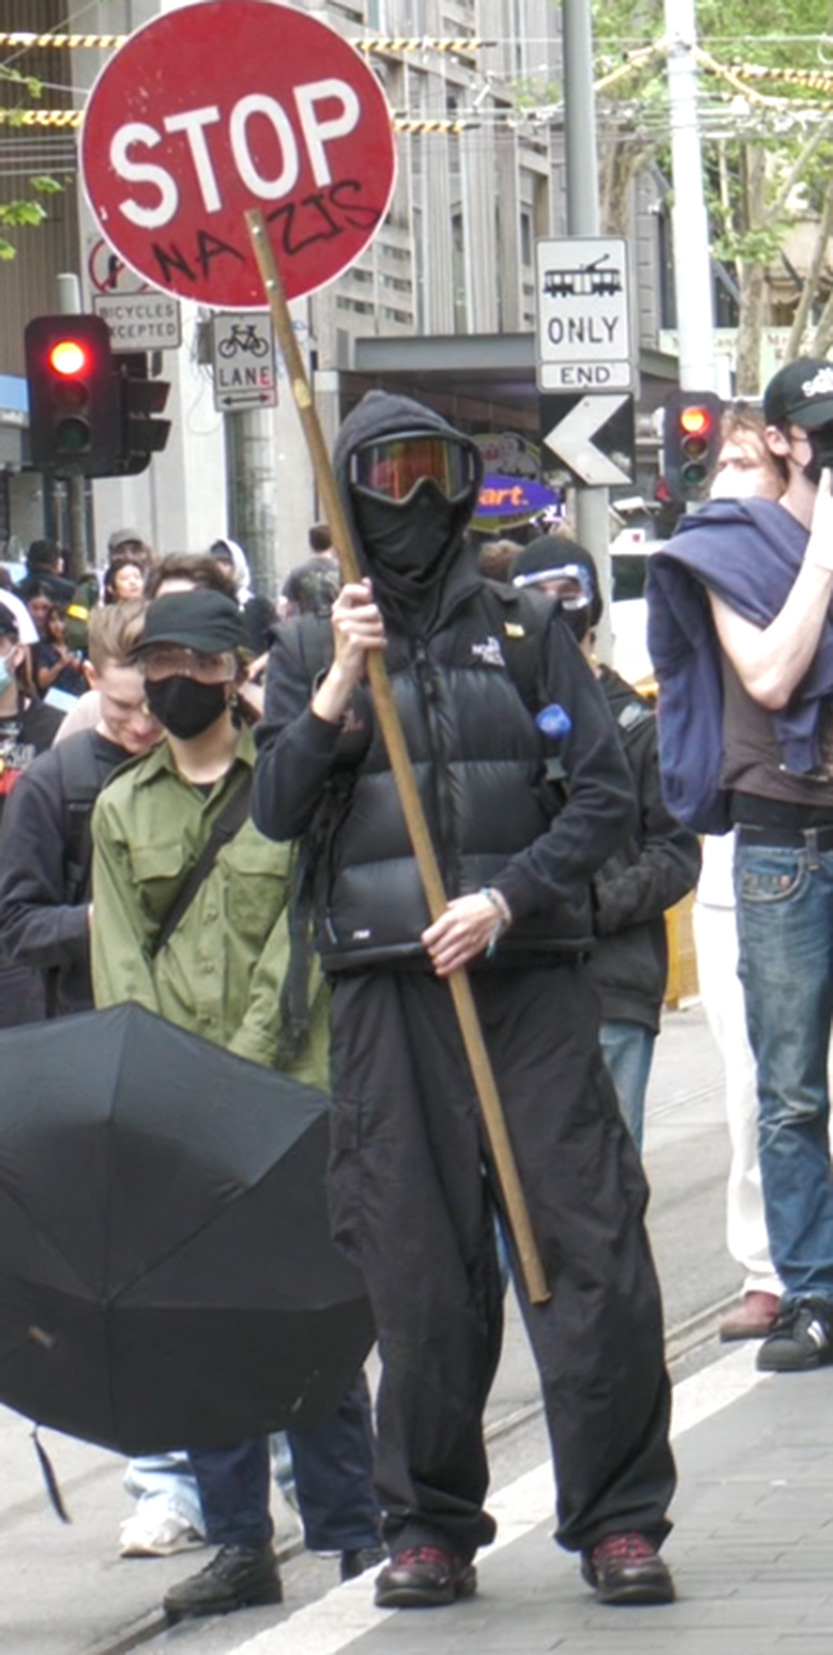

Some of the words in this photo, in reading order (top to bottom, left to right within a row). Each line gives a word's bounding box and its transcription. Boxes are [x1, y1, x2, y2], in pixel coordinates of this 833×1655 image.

[110, 78, 360, 229] STOP
[99, 303, 174, 319] BICYCLES
[109, 322, 176, 339] XCEPTED
[548, 316, 619, 345] ONLY
[219, 366, 271, 387] LANE
[560, 366, 611, 384] END
